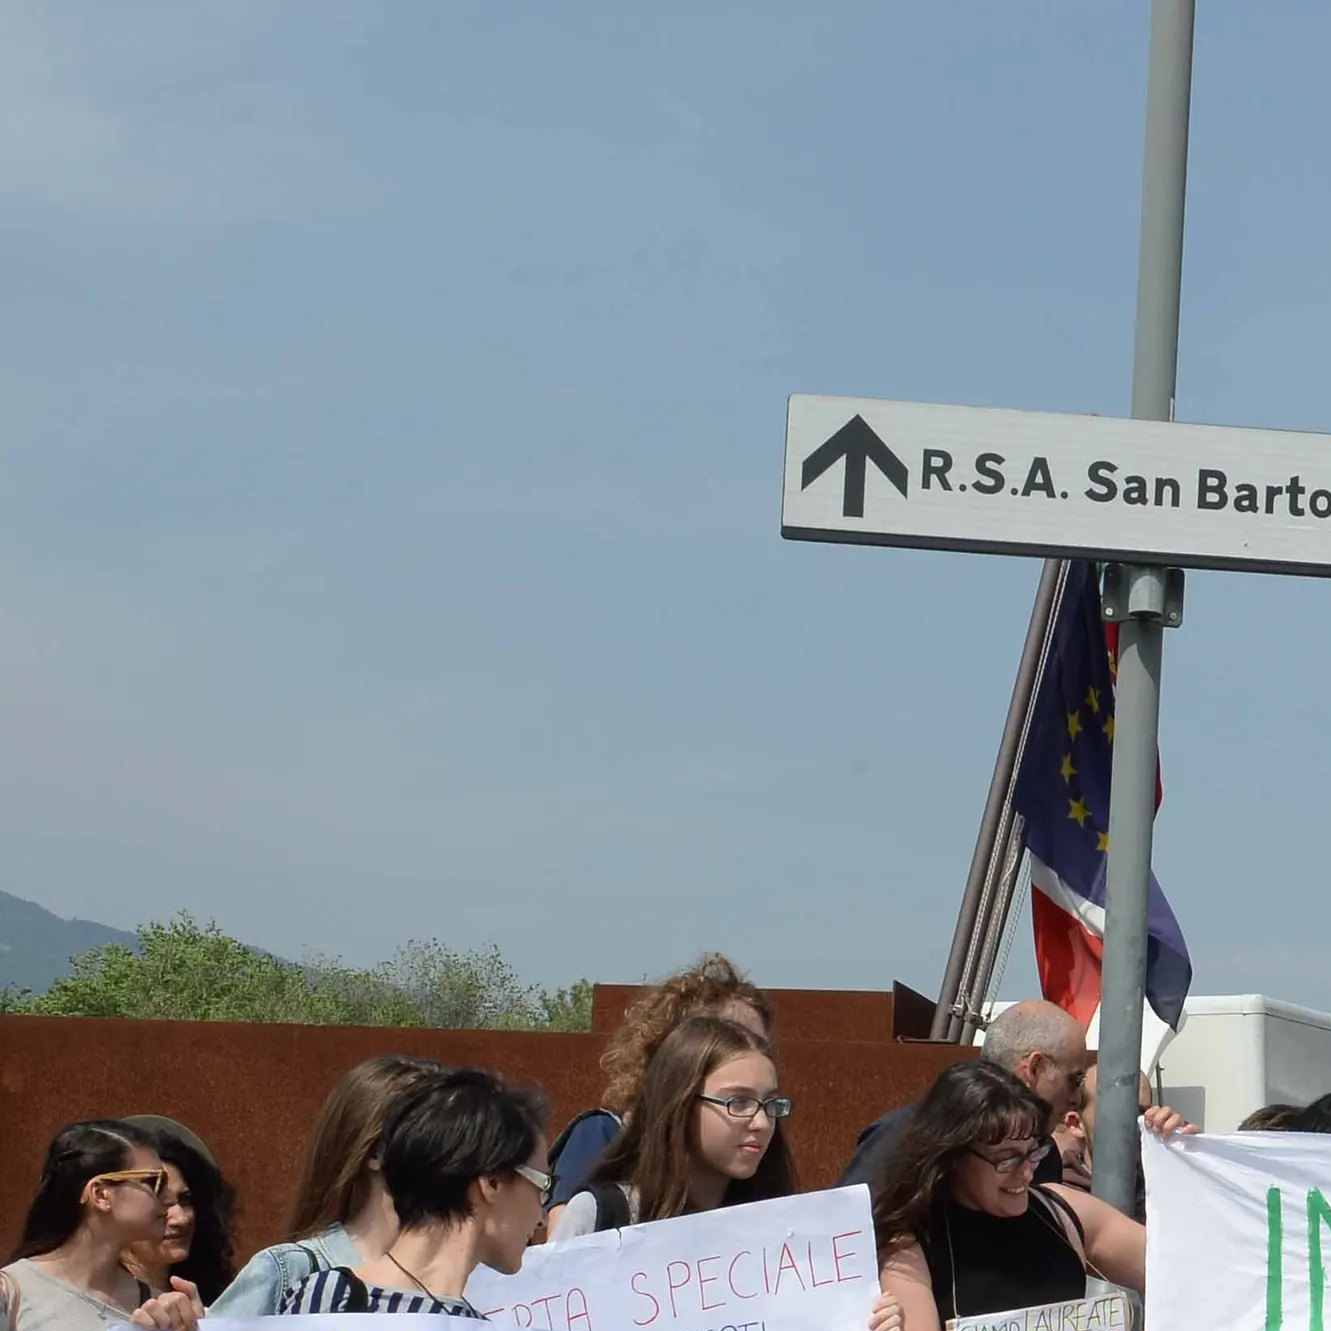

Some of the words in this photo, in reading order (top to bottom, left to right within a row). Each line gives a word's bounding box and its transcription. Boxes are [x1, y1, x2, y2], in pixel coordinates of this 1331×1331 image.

[920, 446, 1069, 501] R.S.A.
[1084, 458, 1180, 509] San
[630, 1230, 864, 1327] SPECIALE
